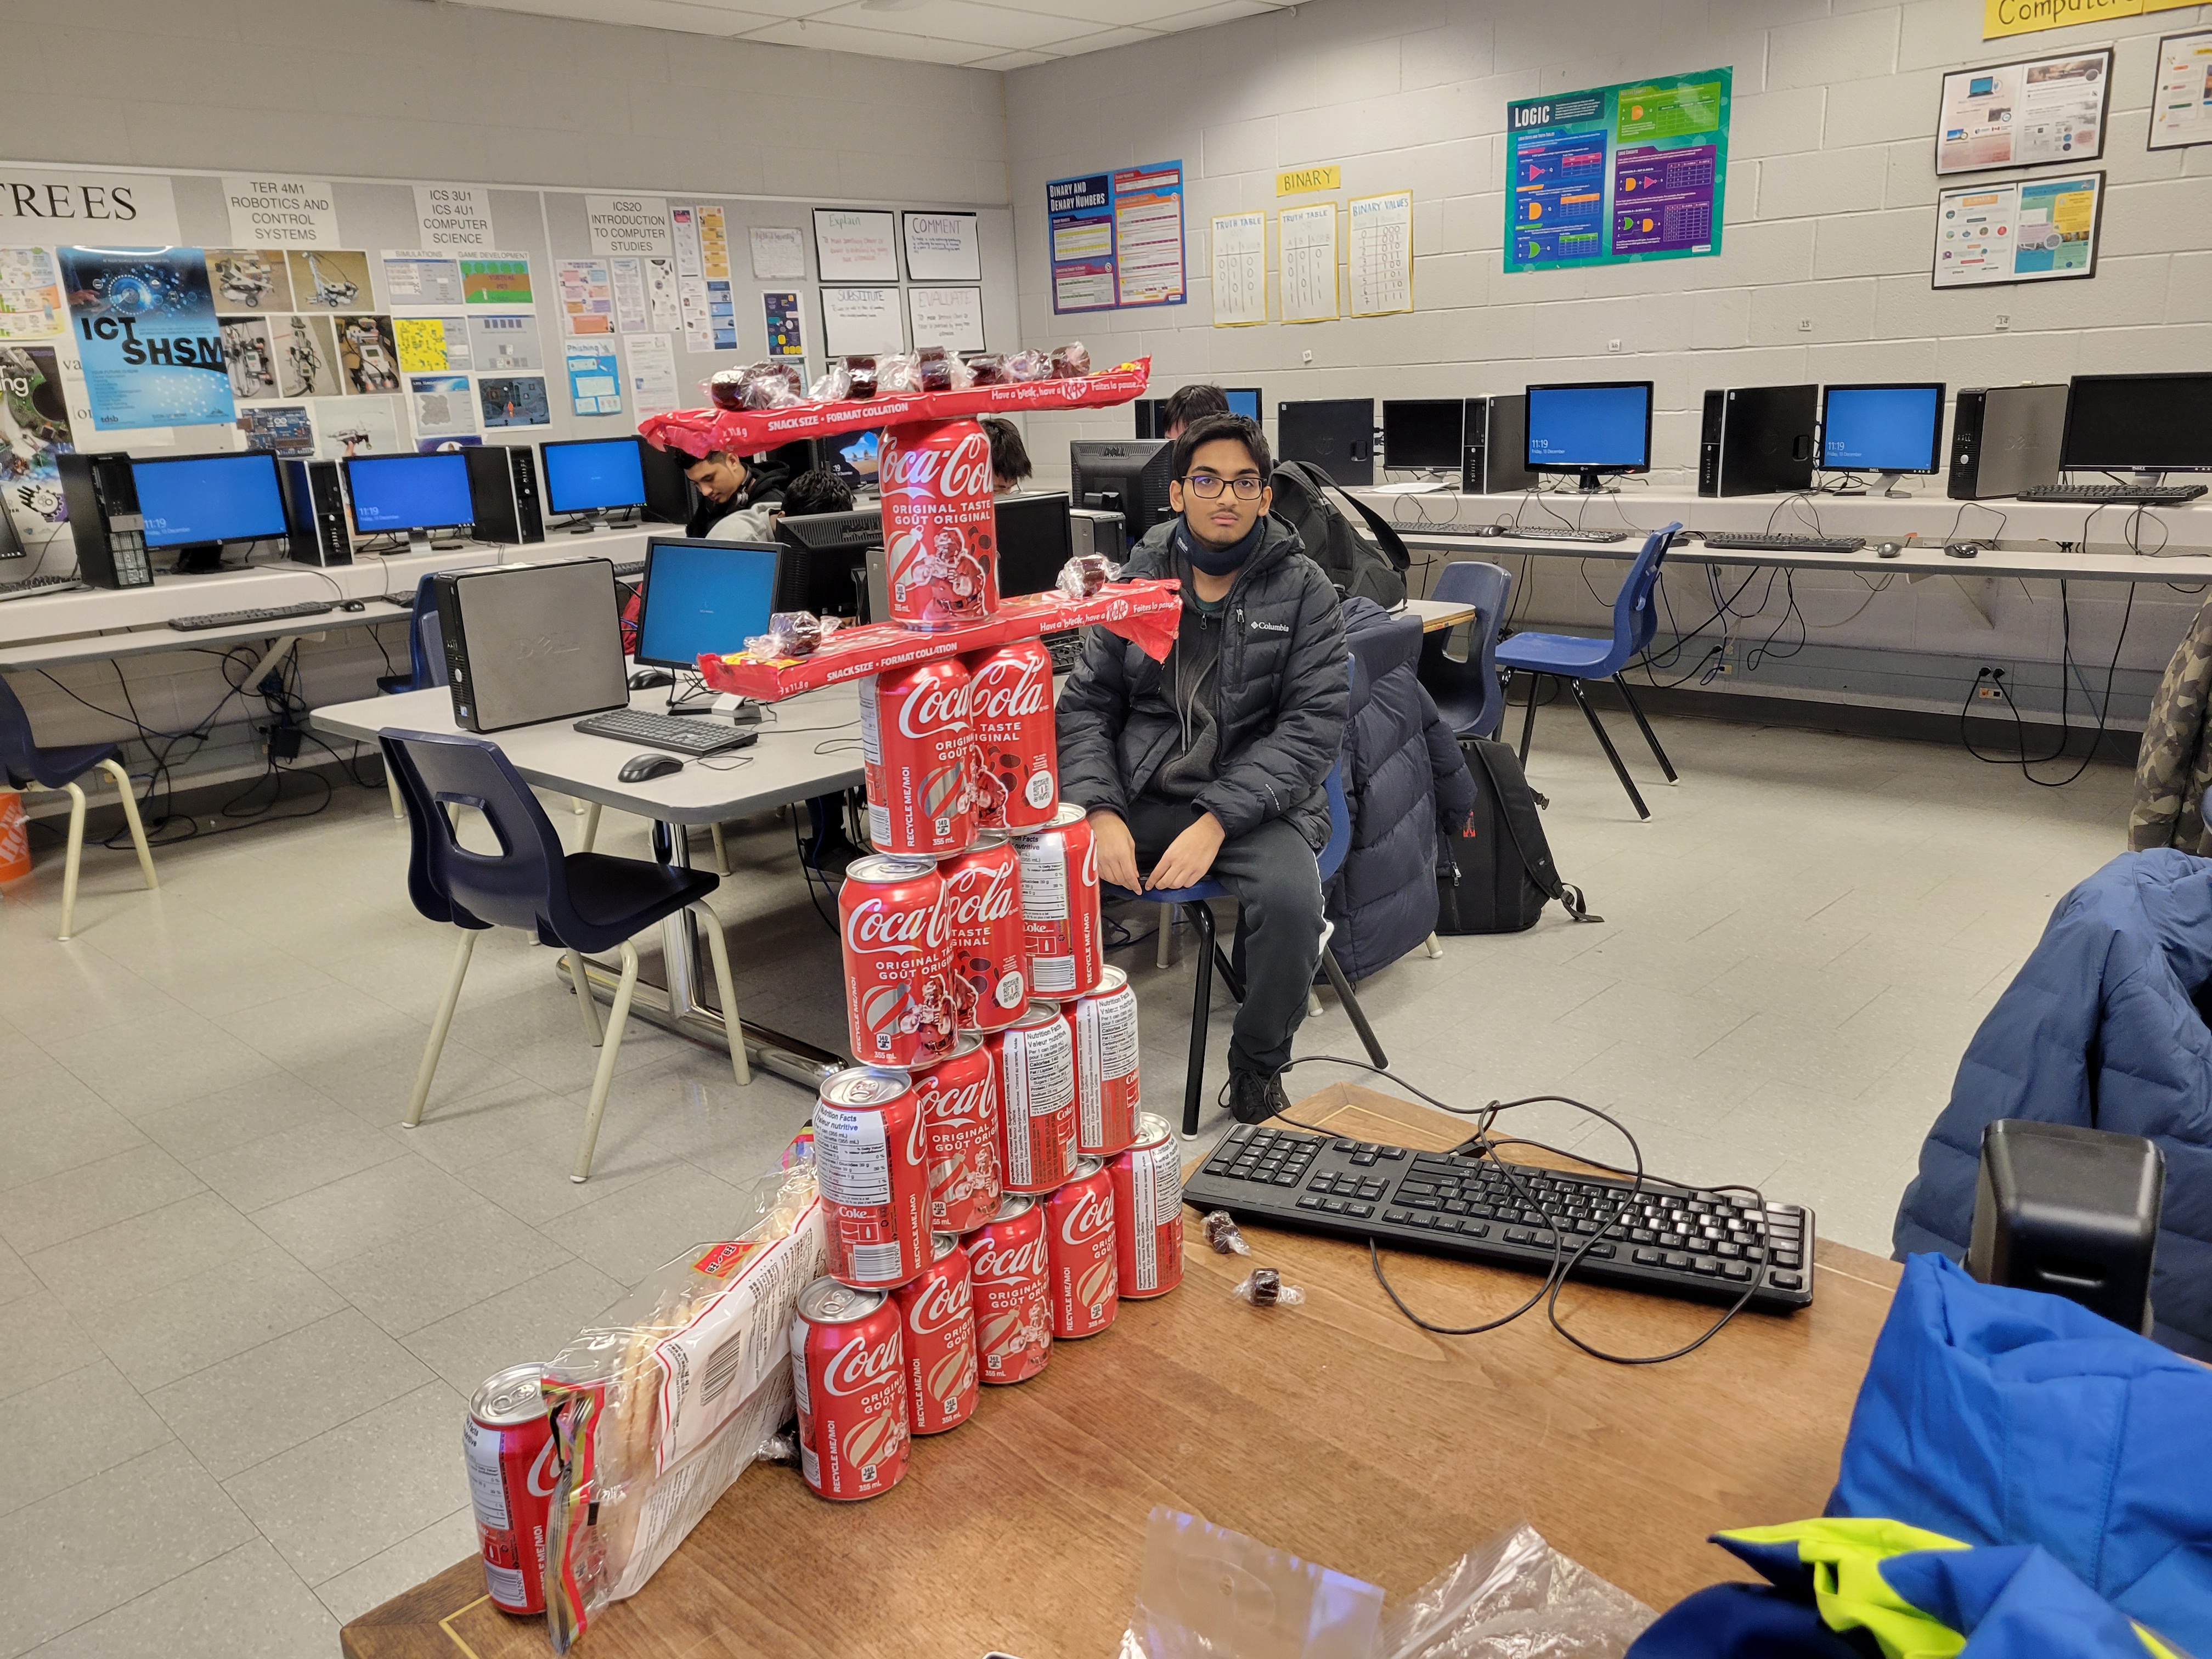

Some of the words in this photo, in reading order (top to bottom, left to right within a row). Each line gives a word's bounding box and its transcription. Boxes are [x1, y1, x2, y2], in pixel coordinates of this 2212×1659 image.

[1515, 105, 1550, 127] LOGIC
[1284, 169, 1332, 191] BINARY
[250, 182, 278, 194] TER
[280, 183, 305, 195] 4M1
[430, 190, 449, 201] ICS
[452, 190, 472, 202] 3U1
[231, 196, 301, 210] ROBOTICS
[304, 199, 329, 211] AND
[432, 204, 451, 216] ICS
[454, 205, 474, 216] 4U1
[1353, 201, 1383, 217] BINARY
[1384, 198, 1409, 210] VALUES
[252, 213, 315, 226] CONTROL
[424, 219, 488, 230] COMPUTER
[591, 215, 665, 226] INTRODUCTION
[828, 213, 861, 230] Explain
[1216, 221, 1238, 230] TRUTH
[1240, 217, 1262, 227] TABLE
[1283, 213, 1304, 224] TRUTH
[1306, 210, 1328, 218] TABLE
[595, 228, 608, 239] TO
[611, 228, 665, 239] COMPUTER
[912, 217, 962, 235] COMMENT
[255, 228, 317, 241] SYSTEMS
[432, 233, 483, 245] SCIENCE
[611, 241, 653, 252] STUDIES
[837, 290, 884, 302] SUBSTITUTE
[918, 291, 972, 308] EVALUATE
[81, 317, 137, 341] ICT
[122, 336, 225, 366] SHSM
[567, 345, 599, 357] Phishing
[991, 390, 1010, 400] Have
[1017, 388, 1037, 400] break,
[1039, 386, 1055, 397] have
[1091, 381, 1109, 392] Faites
[1110, 381, 1117, 390] la
[768, 417, 799, 431] SNACK
[799, 416, 819, 426] SIZE
[826, 411, 863, 423] FORMAT
[863, 402, 909, 418] COLLATION
[1532, 439, 1548, 449] 11:19
[1827, 441, 1845, 451] 11:19
[359, 506, 379, 516] 11:19
[892, 504, 956, 514] ORIGINAL
[960, 499, 991, 512] TASTE
[144, 518, 167, 529] 11:19
[895, 514, 929, 526] GOÛT
[934, 511, 991, 524] ORIGINAL
[1040, 620, 1056, 633] Have
[1063, 615, 1085, 629] break,
[1085, 613, 1100, 624] have
[1133, 603, 1152, 613] Faites
[1258, 622, 1289, 633] Columbia
[827, 668, 855, 682] SNACK
[854, 662, 874, 674] SIZE
[881, 651, 915, 668] FORMAT
[916, 642, 957, 659] COLLATION
[790, 682, 803, 692] 11.8
[803, 680, 809, 691] g
[980, 722, 1022, 732] TASTE
[938, 745, 968, 761] GOÛT
[902, 766, 912, 804] ME/MOI
[905, 805, 915, 848] RECYCLE
[932, 837, 945, 846] 355
[945, 835, 955, 844] mL
[1022, 835, 1039, 843] Facts
[951, 927, 991, 937] TASTE
[876, 953, 939, 969] ORIGINAL
[879, 968, 917, 980] GOÛT
[851, 976, 859, 1012] ME/MOI
[1099, 996, 1121, 1007] Nutrition
[1027, 1030, 1051, 1040] Nutrition
[1050, 1023, 1062, 1034] Facts
[1028, 1039, 1047, 1048] Valeur
[1048, 1030, 1066, 1044] nutritive
[820, 1107, 839, 1121] Nutrition
[839, 1114, 857, 1122] Facts
[1057, 1105, 1073, 1121] Coke
[817, 1114, 831, 1127] Valeur
[831, 1122, 859, 1132] nutritive
[932, 1123, 990, 1143] ORIGINAL
[935, 1139, 971, 1152] GOÛT
[838, 1206, 867, 1219] Coke
[909, 1193, 918, 1231] ME/MOI
[912, 1231, 922, 1269] RECYCLE
[1064, 1267, 1073, 1297] ME/MOI
[988, 1279, 1042, 1301] ORIGINAL
[991, 1296, 1025, 1309] GOÛT
[1065, 1297, 1074, 1331] RECYCLE
[946, 1327, 970, 1349] GOÛT
[912, 1358, 922, 1393] ME/MOI
[864, 1392, 895, 1414] GOÛT
[915, 1392, 926, 1428] RECYCLE
[941, 1415, 953, 1425] 355
[827, 1420, 838, 1454] ME/MOI
[831, 1454, 841, 1493] RECYCLE
[858, 1483, 871, 1492] 355
[871, 1480, 882, 1488] mL
[533, 1525, 545, 1562] ME/MOI
